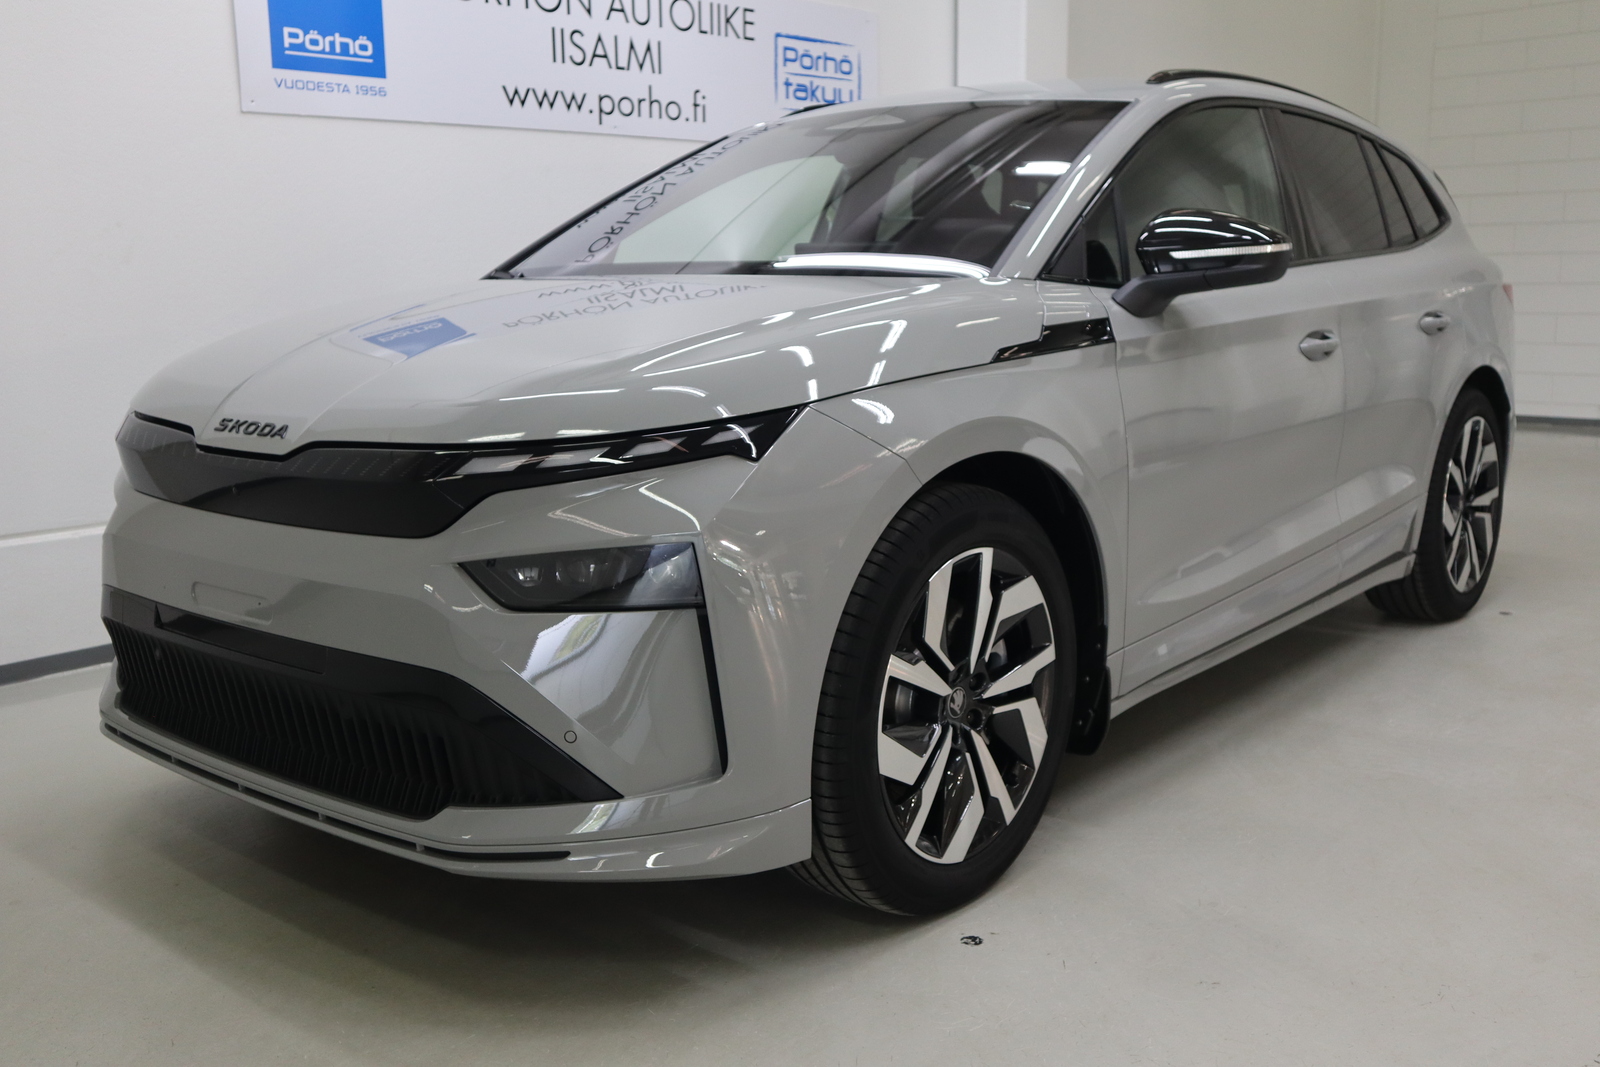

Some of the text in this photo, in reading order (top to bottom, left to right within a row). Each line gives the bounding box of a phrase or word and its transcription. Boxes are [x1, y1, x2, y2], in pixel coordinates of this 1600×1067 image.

[283, 26, 374, 57] Pörhö
[551, 26, 663, 75] IISALMI
[783, 45, 854, 76] Pörhö
[273, 77, 388, 97] VUODESTA 1956
[783, 77, 854, 104] takuu
[501, 84, 707, 126] www.porho.fi
